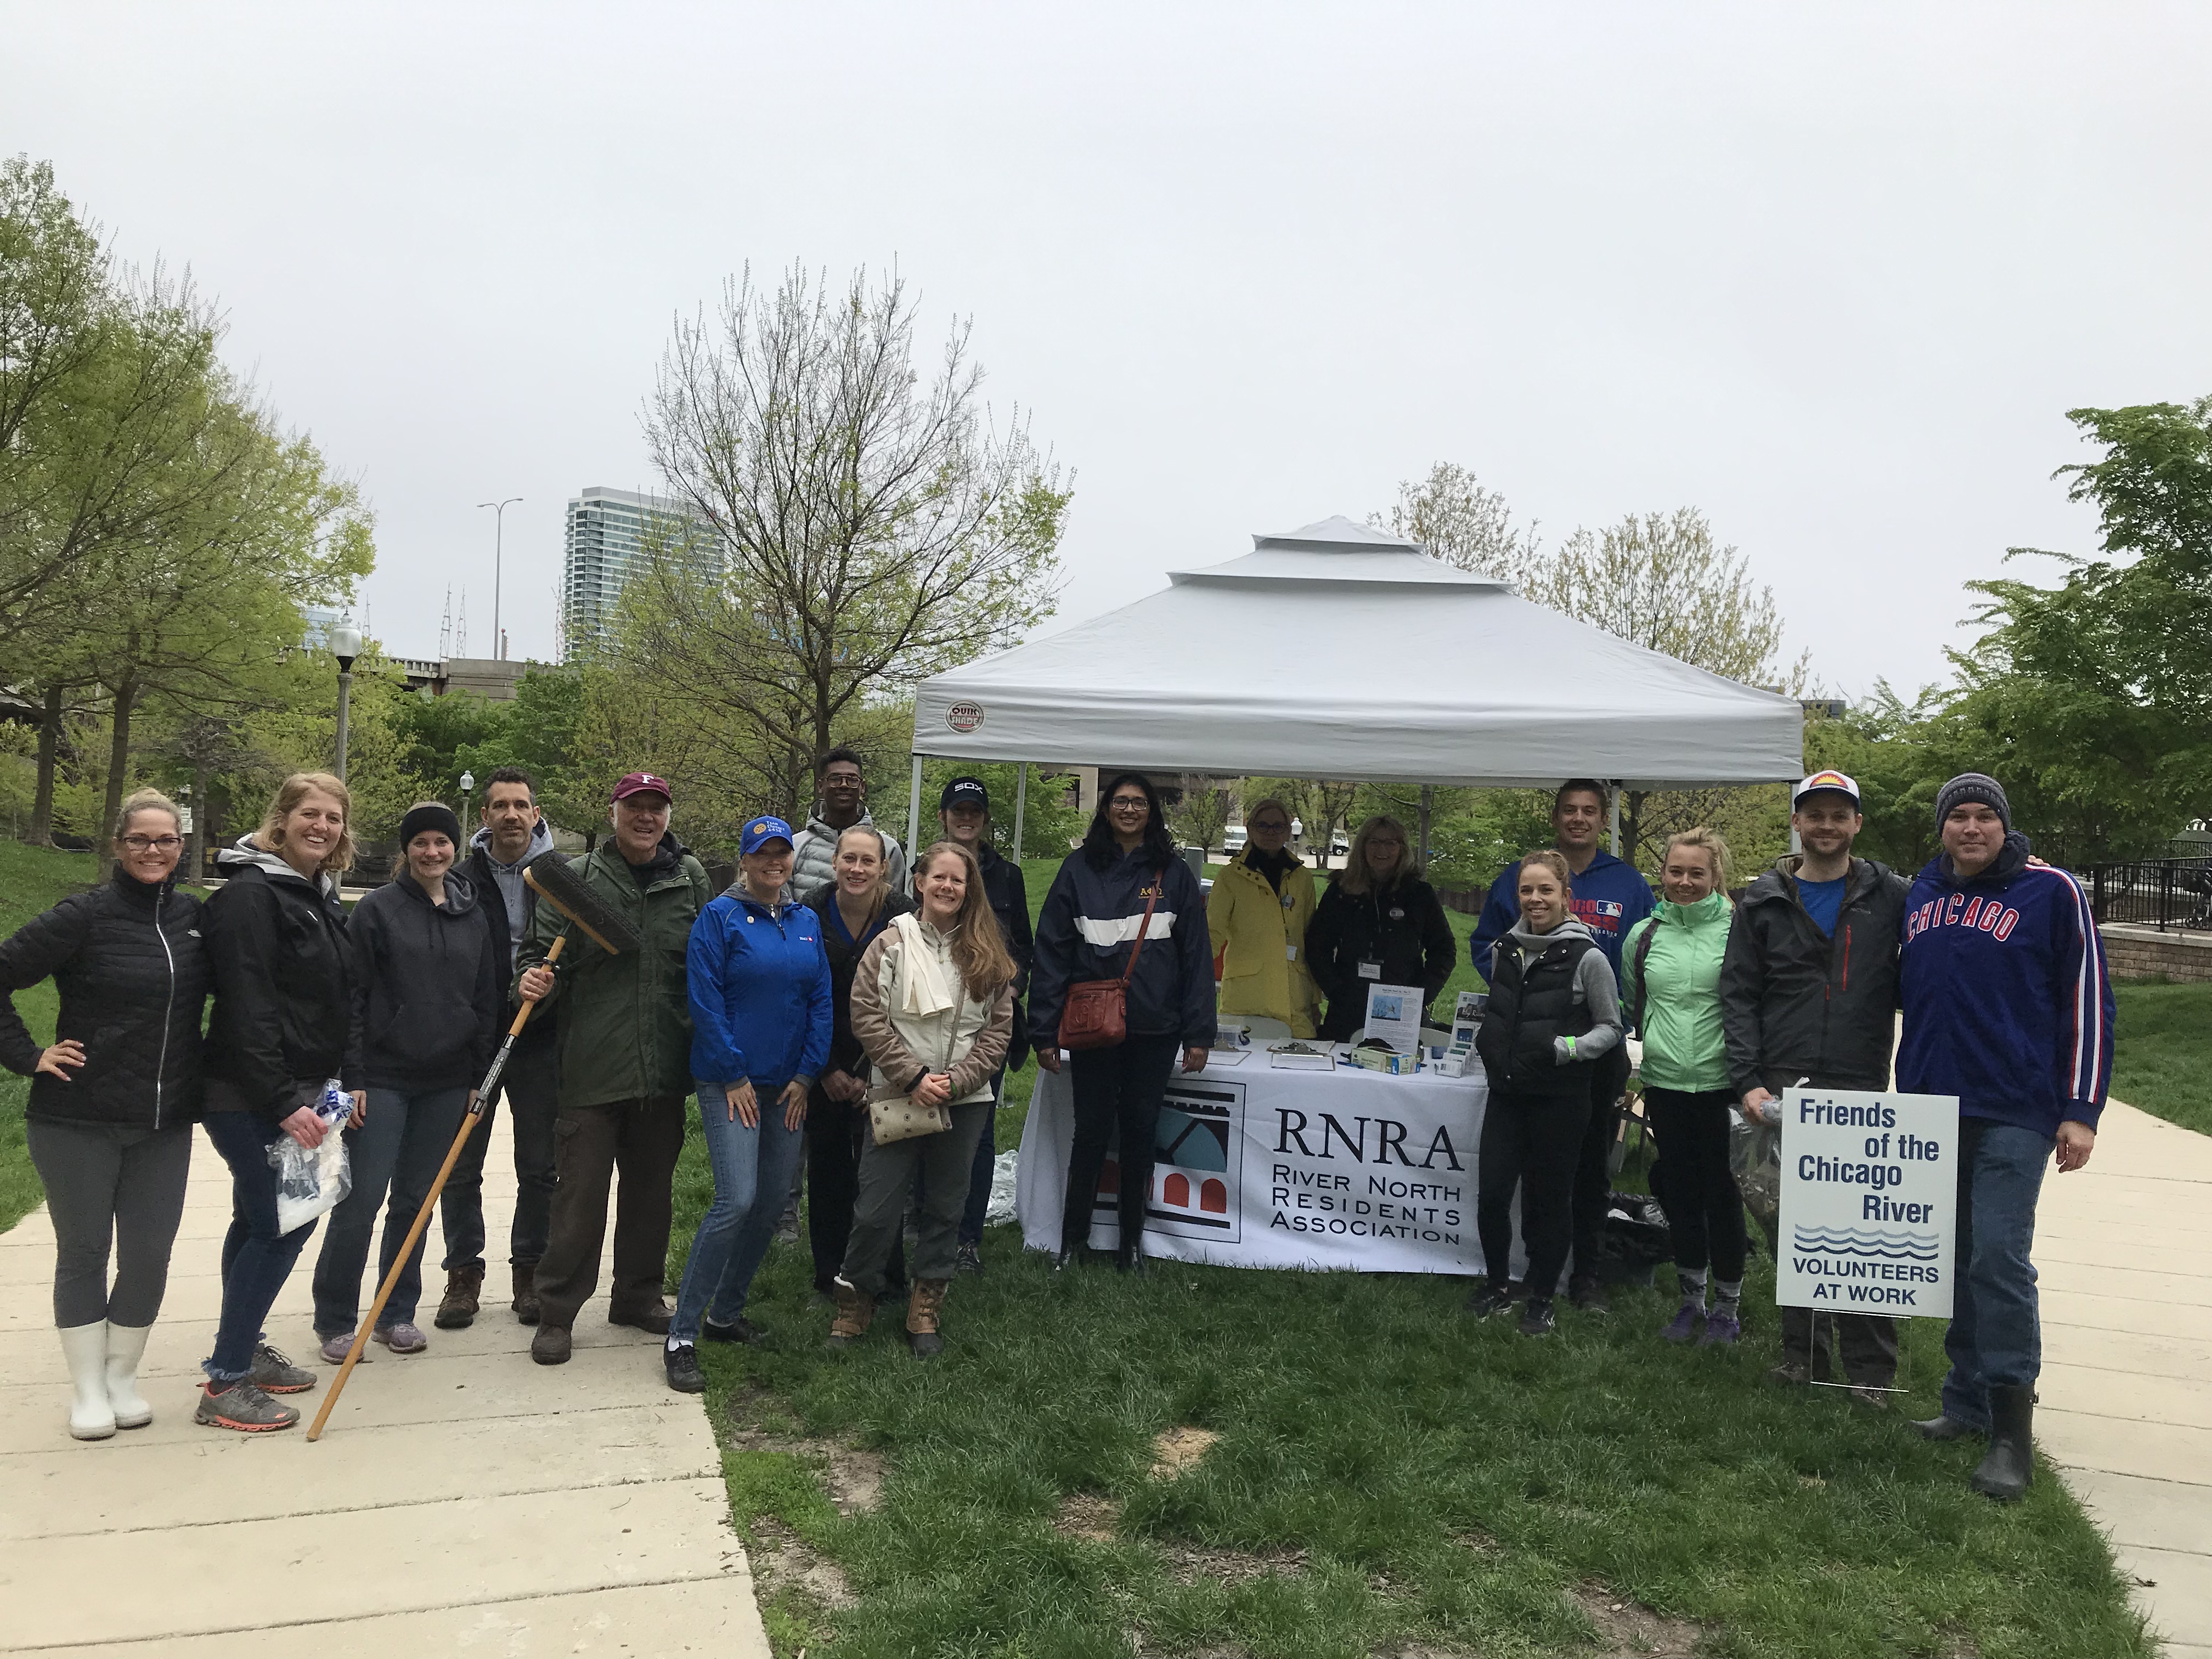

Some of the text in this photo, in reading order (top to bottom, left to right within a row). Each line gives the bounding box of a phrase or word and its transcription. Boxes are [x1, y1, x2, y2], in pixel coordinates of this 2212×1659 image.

[951, 716, 978, 725] SHADE
[641, 775, 654, 783] F
[955, 782, 983, 794] SOX
[1907, 892, 2020, 943] CHICAGO
[1800, 1098, 1896, 1128] Friends
[1273, 1108, 1465, 1172] RNRA
[1865, 1133, 1939, 1161] of the
[1273, 1164, 1461, 1202] RIVER NORTH
[1798, 1155, 1902, 1190] Chicago
[1273, 1187, 1460, 1226] RESIDENTS
[1863, 1195, 1933, 1223] River
[1270, 1211, 1459, 1245] ASSOCIATION
[1793, 1258, 1939, 1283] VOLUNTEERS
[1813, 1283, 1916, 1306] AT WORK
